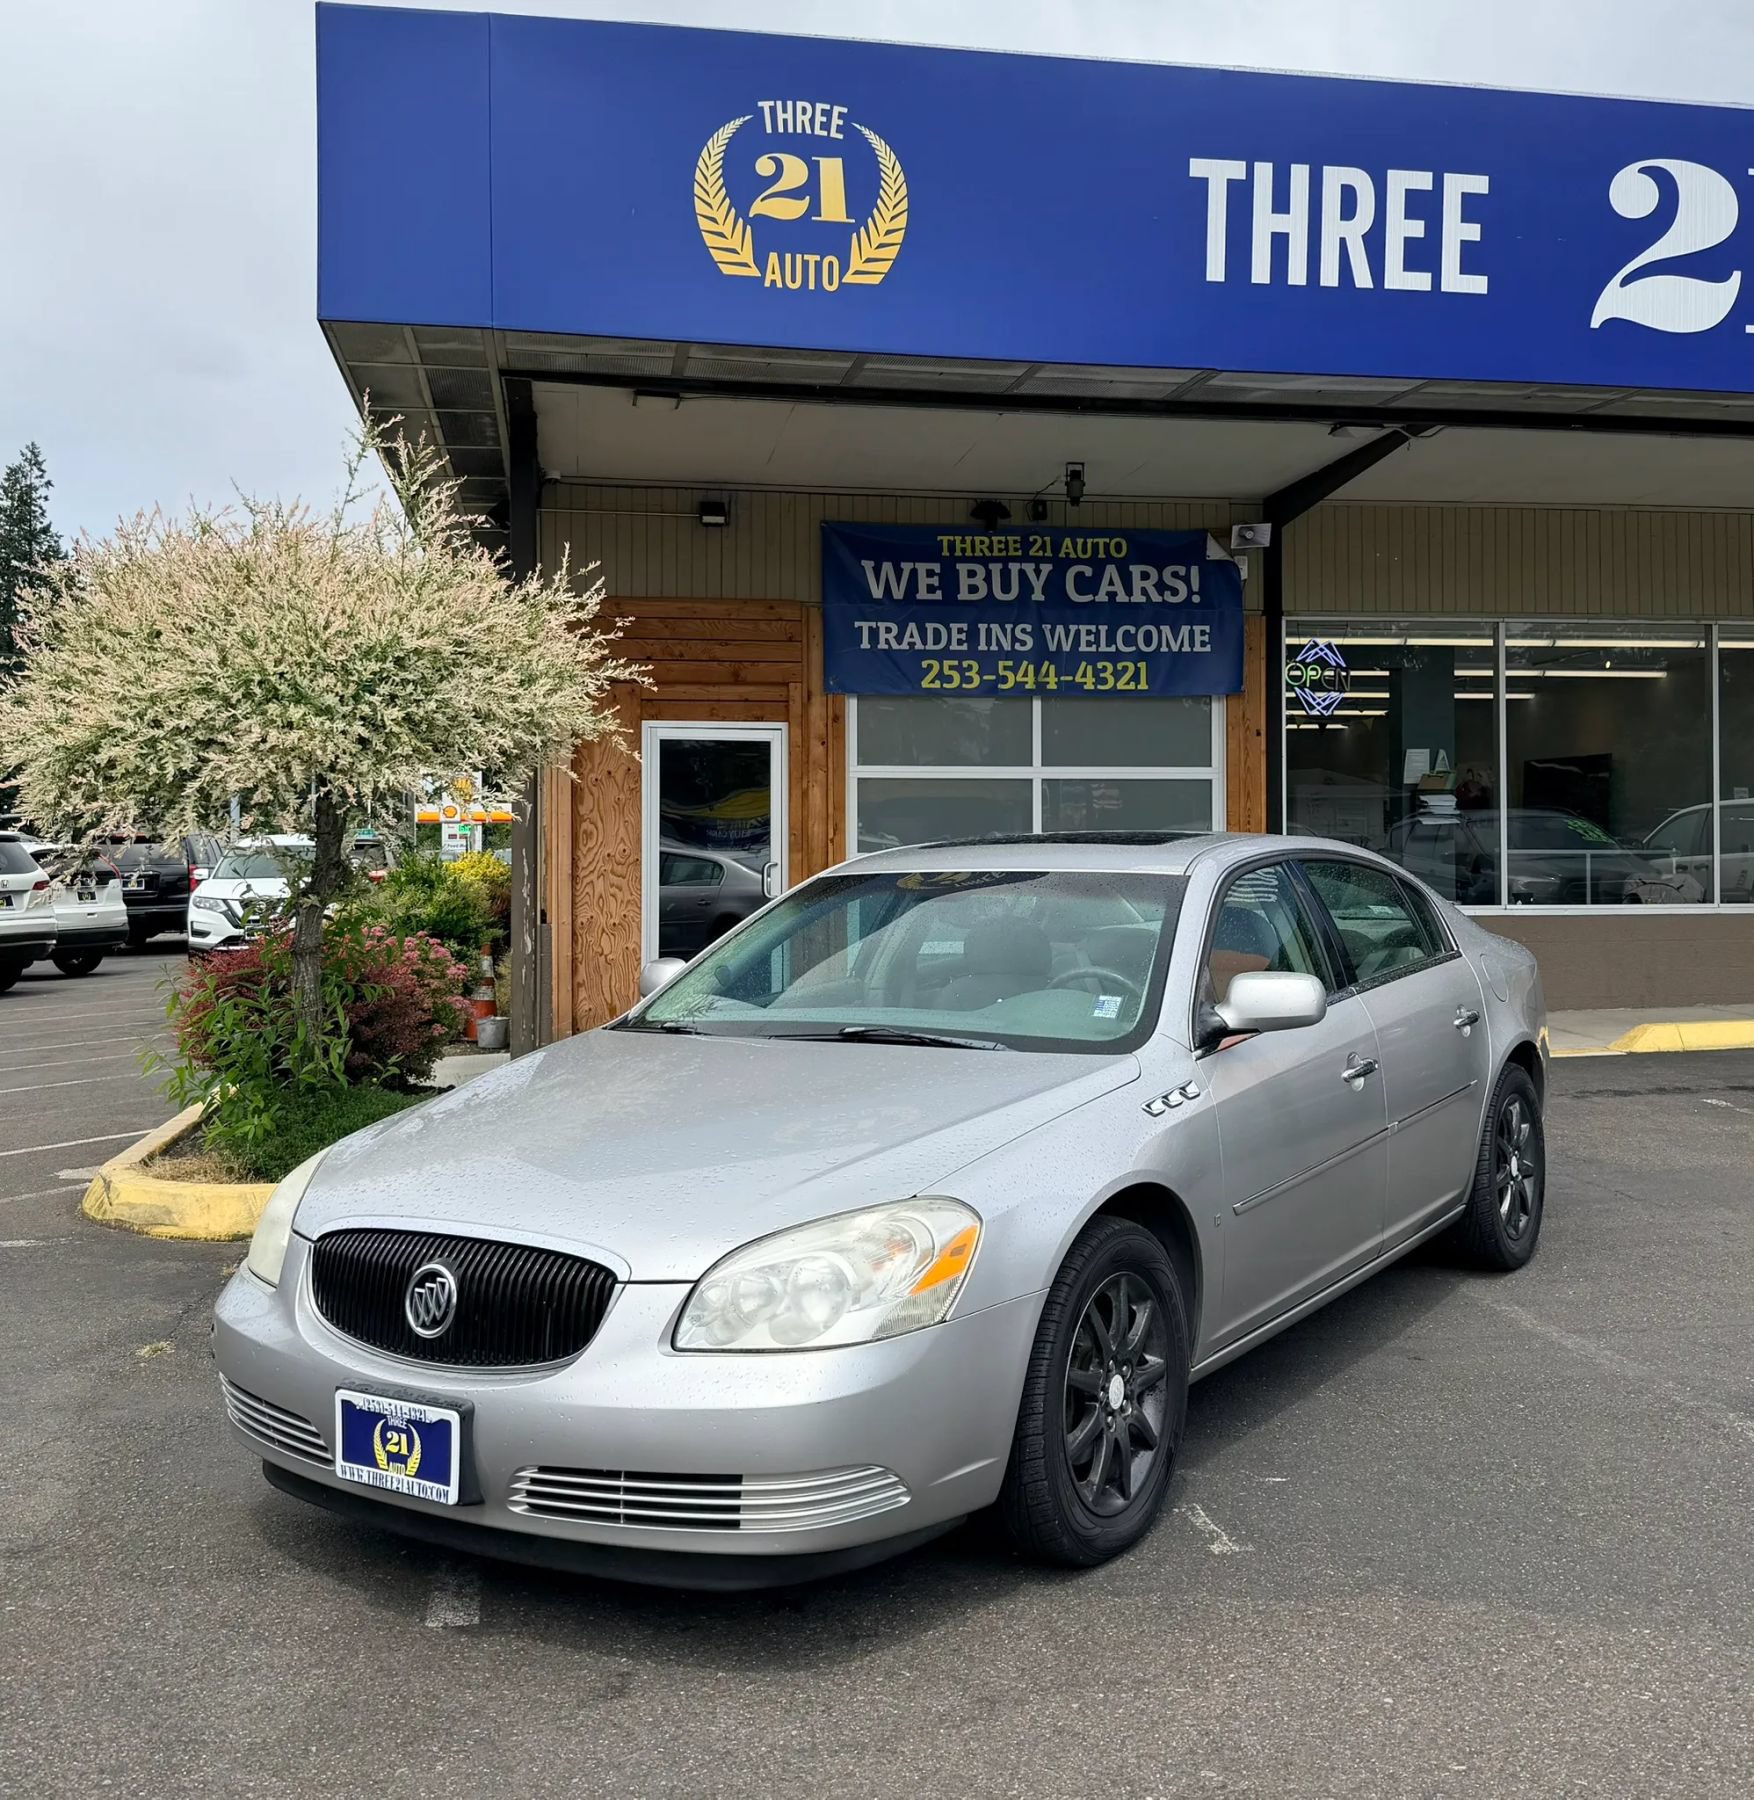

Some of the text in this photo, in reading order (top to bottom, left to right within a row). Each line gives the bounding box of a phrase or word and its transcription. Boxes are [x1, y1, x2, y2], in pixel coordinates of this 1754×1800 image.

[758, 101, 848, 139] THREE
[749, 153, 855, 222] 21
[1190, 158, 1754, 333] THREE 2
[764, 252, 840, 291] AUTO
[937, 536, 1128, 559] THREE 21 AUTO
[861, 560, 1201, 603] WE BUY CARS!
[854, 621, 1212, 653] TRADE INS WELCOME
[921, 660, 1149, 690] 253-544-4321
[1285, 662, 1350, 692] OPEN
[387, 1416, 408, 1429] THREE
[386, 1431, 409, 1456] 21
[388, 1461, 406, 1476] AUTO
